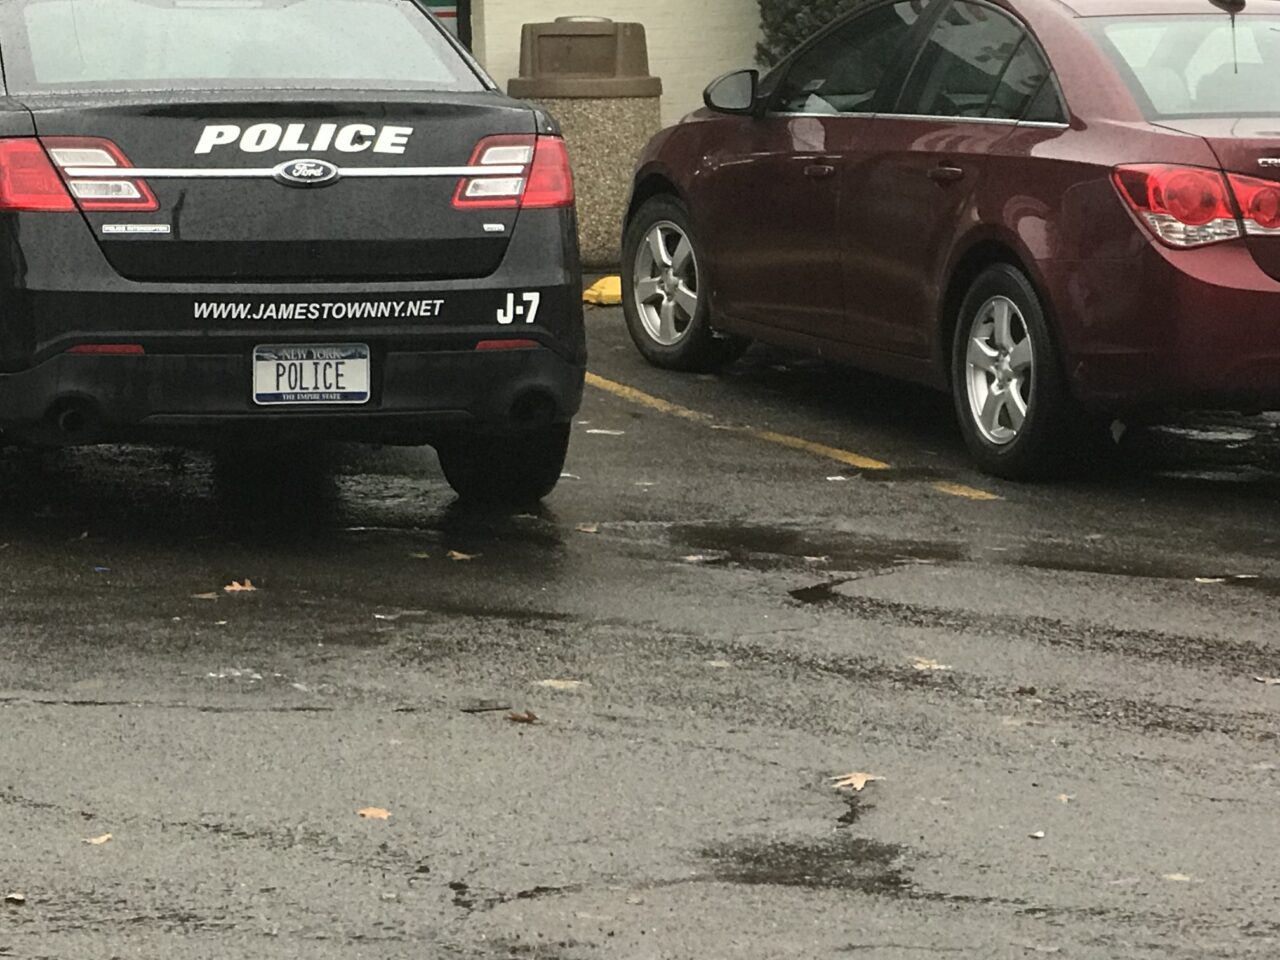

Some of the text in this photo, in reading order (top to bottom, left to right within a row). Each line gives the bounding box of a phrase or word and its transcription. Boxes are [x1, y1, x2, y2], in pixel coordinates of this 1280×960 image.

[194, 123, 414, 154] POLICE
[292, 163, 324, 177] Ford
[193, 299, 444, 320] WWW.JAMESTOWNNY.NET
[496, 292, 541, 325] J-7
[281, 348, 342, 360] NEW YORK
[275, 361, 346, 391] POLICE
[282, 392, 341, 401] THE EMPIRE STATE
